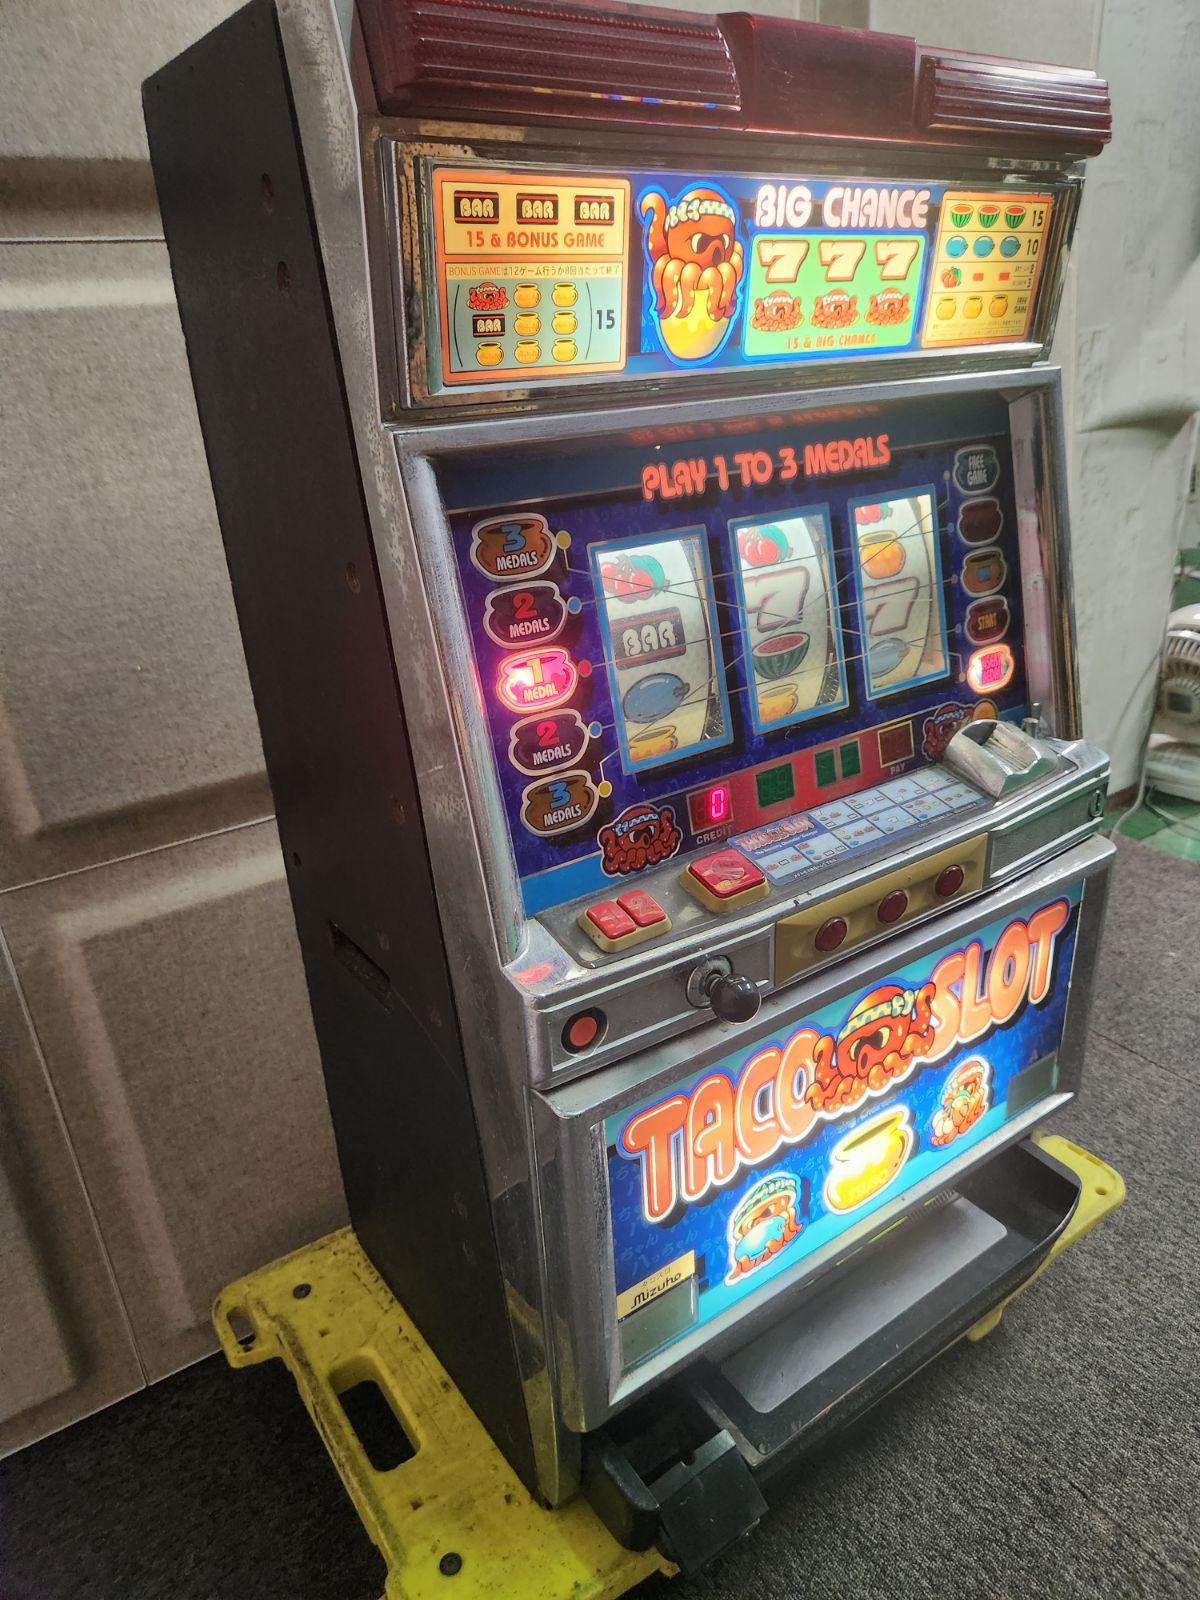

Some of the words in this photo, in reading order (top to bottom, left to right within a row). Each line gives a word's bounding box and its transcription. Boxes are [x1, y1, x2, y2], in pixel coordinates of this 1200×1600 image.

[459, 197, 495, 218] BAR
[521, 199, 554, 219] BAR
[579, 201, 610, 220] BAR
[755, 184, 813, 229] BIG
[823, 186, 931, 229] CHANCE
[1031, 210, 1044, 227] 15
[466, 231, 485, 248] 15
[490, 233, 501, 248] &
[507, 231, 558, 248] BONUS
[563, 232, 605, 248] GAME
[1026, 239, 1039, 256] 10
[757, 239, 809, 283] 7
[818, 239, 866, 283] 7
[874, 239, 919, 281] 7
[476, 318, 502, 334] BAR
[596, 309, 615, 330] 15
[786, 337, 799, 351] 15
[815, 335, 835, 349] BIG
[838, 333, 877, 347] CHANCE
[641, 462, 707, 501] PLAY
[712, 455, 730, 491] 1
[734, 449, 774, 488] TO
[778, 447, 798, 480] 3
[803, 433, 891, 477] MEDALS
[968, 454, 985, 471] FREE
[966, 468, 988, 486] GAME
[501, 523, 527, 553] 3
[495, 551, 539, 571] MEDALS
[512, 591, 538, 619] 2
[509, 617, 550, 639] MEDALS
[977, 612, 997, 631] START
[621, 619, 678, 657] BAR
[525, 657, 545, 685] 1
[523, 682, 559, 703] MEDAL
[535, 720, 560, 748] 2
[532, 743, 572, 765] MEDALS
[890, 762, 905, 776] PAY
[547, 782, 571, 810] 3
[711, 789, 725, 818] 0
[543, 804, 582, 827] MEDALS
[696, 825, 733, 845] CREDIT
[619, 1028, 821, 1223] TACO
[926, 897, 1070, 1056] SLOT
[630, 1272, 682, 1310] Mizuho
